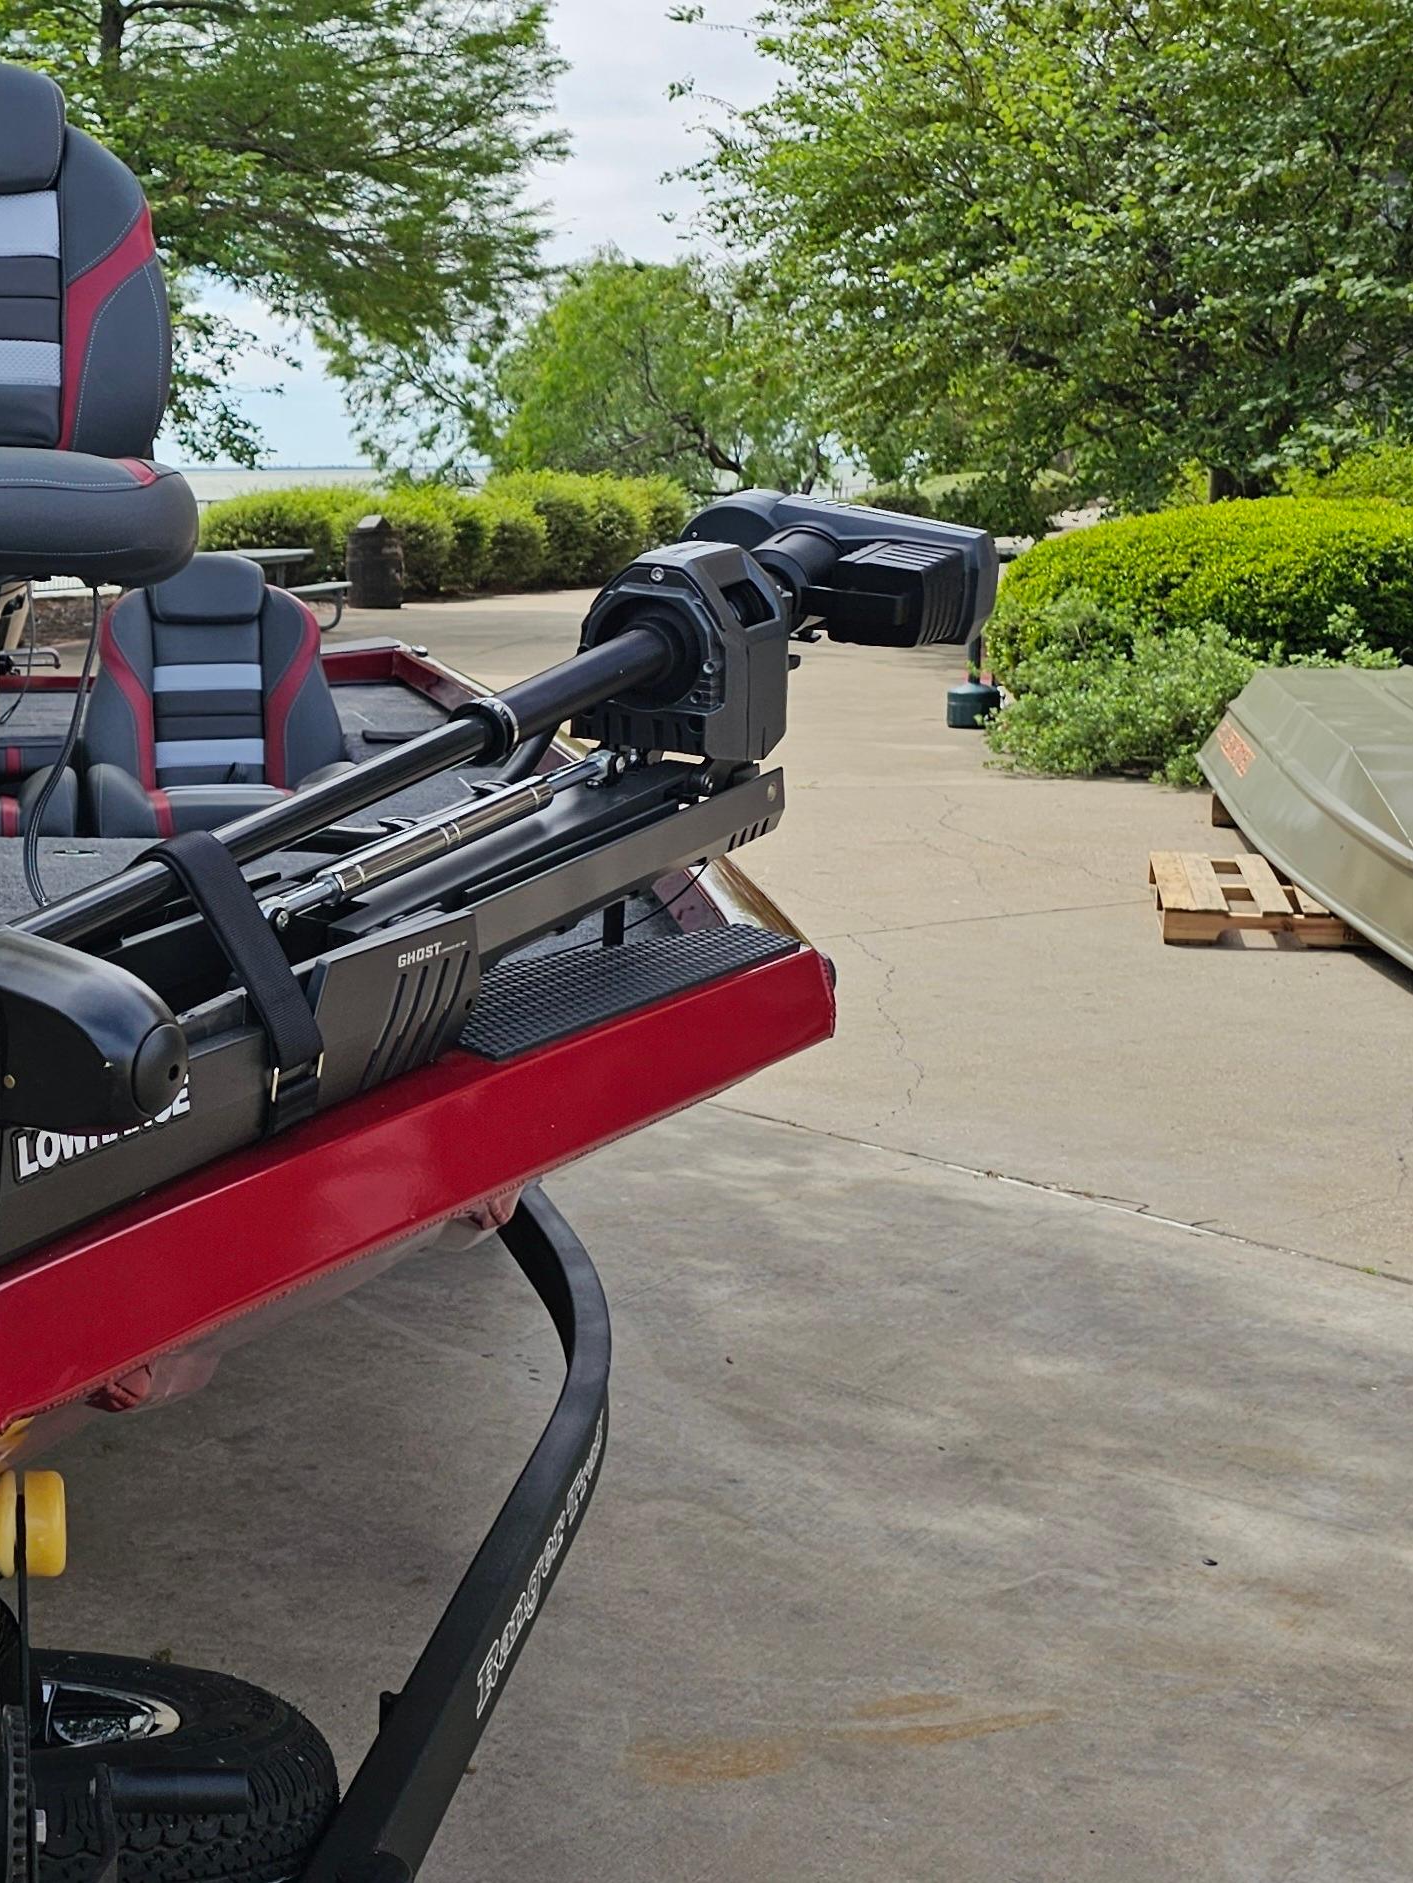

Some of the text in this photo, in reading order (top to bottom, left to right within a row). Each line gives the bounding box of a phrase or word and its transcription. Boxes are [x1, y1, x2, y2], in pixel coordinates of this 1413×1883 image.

[397, 941, 442, 968] GHOST
[17, 1073, 190, 1178] LOWE
[476, 1510, 567, 1719] Ranger
